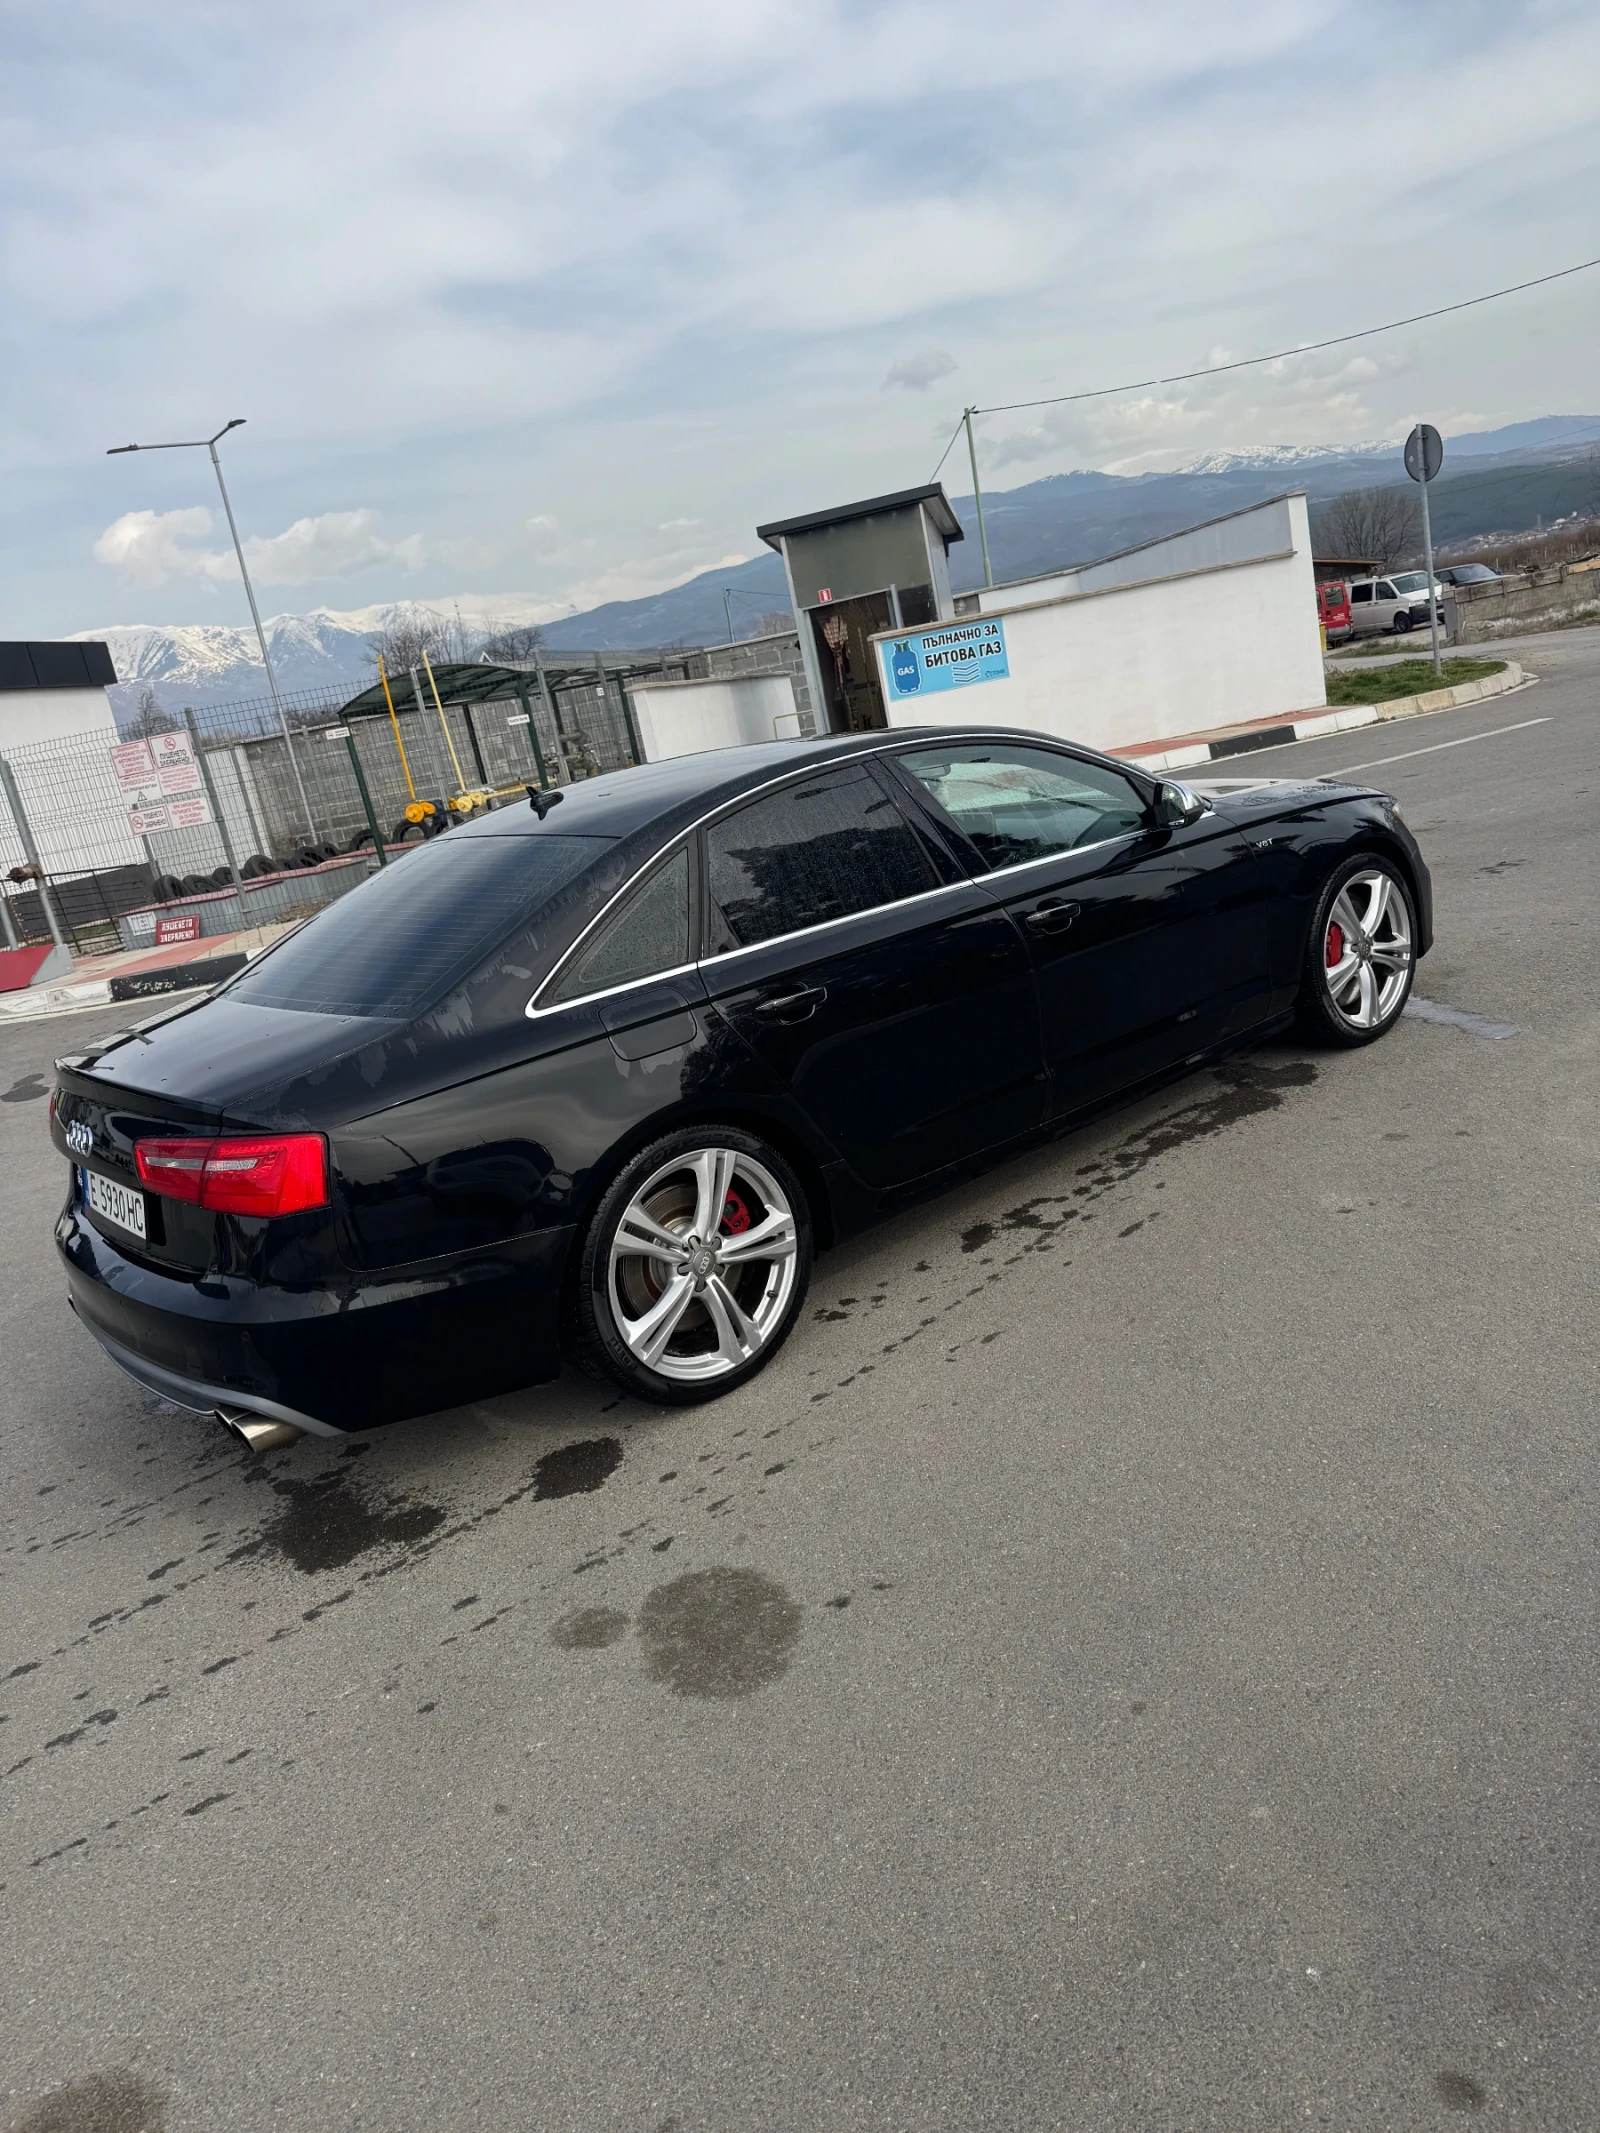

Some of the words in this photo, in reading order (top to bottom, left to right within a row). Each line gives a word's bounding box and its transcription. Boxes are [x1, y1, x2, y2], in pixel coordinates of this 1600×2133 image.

[922, 627, 981, 650] ПЪЛНАЧНО
[984, 624, 999, 636] ЗА
[925, 646, 976, 668] БИТОВА
[979, 641, 1002, 657] ГАЗ
[897, 666, 915, 676] GAS
[1256, 837, 1273, 848] V8T
[161, 918, 193, 932] ПУШЕНЕТО
[100, 1180, 126, 1223] 5930
